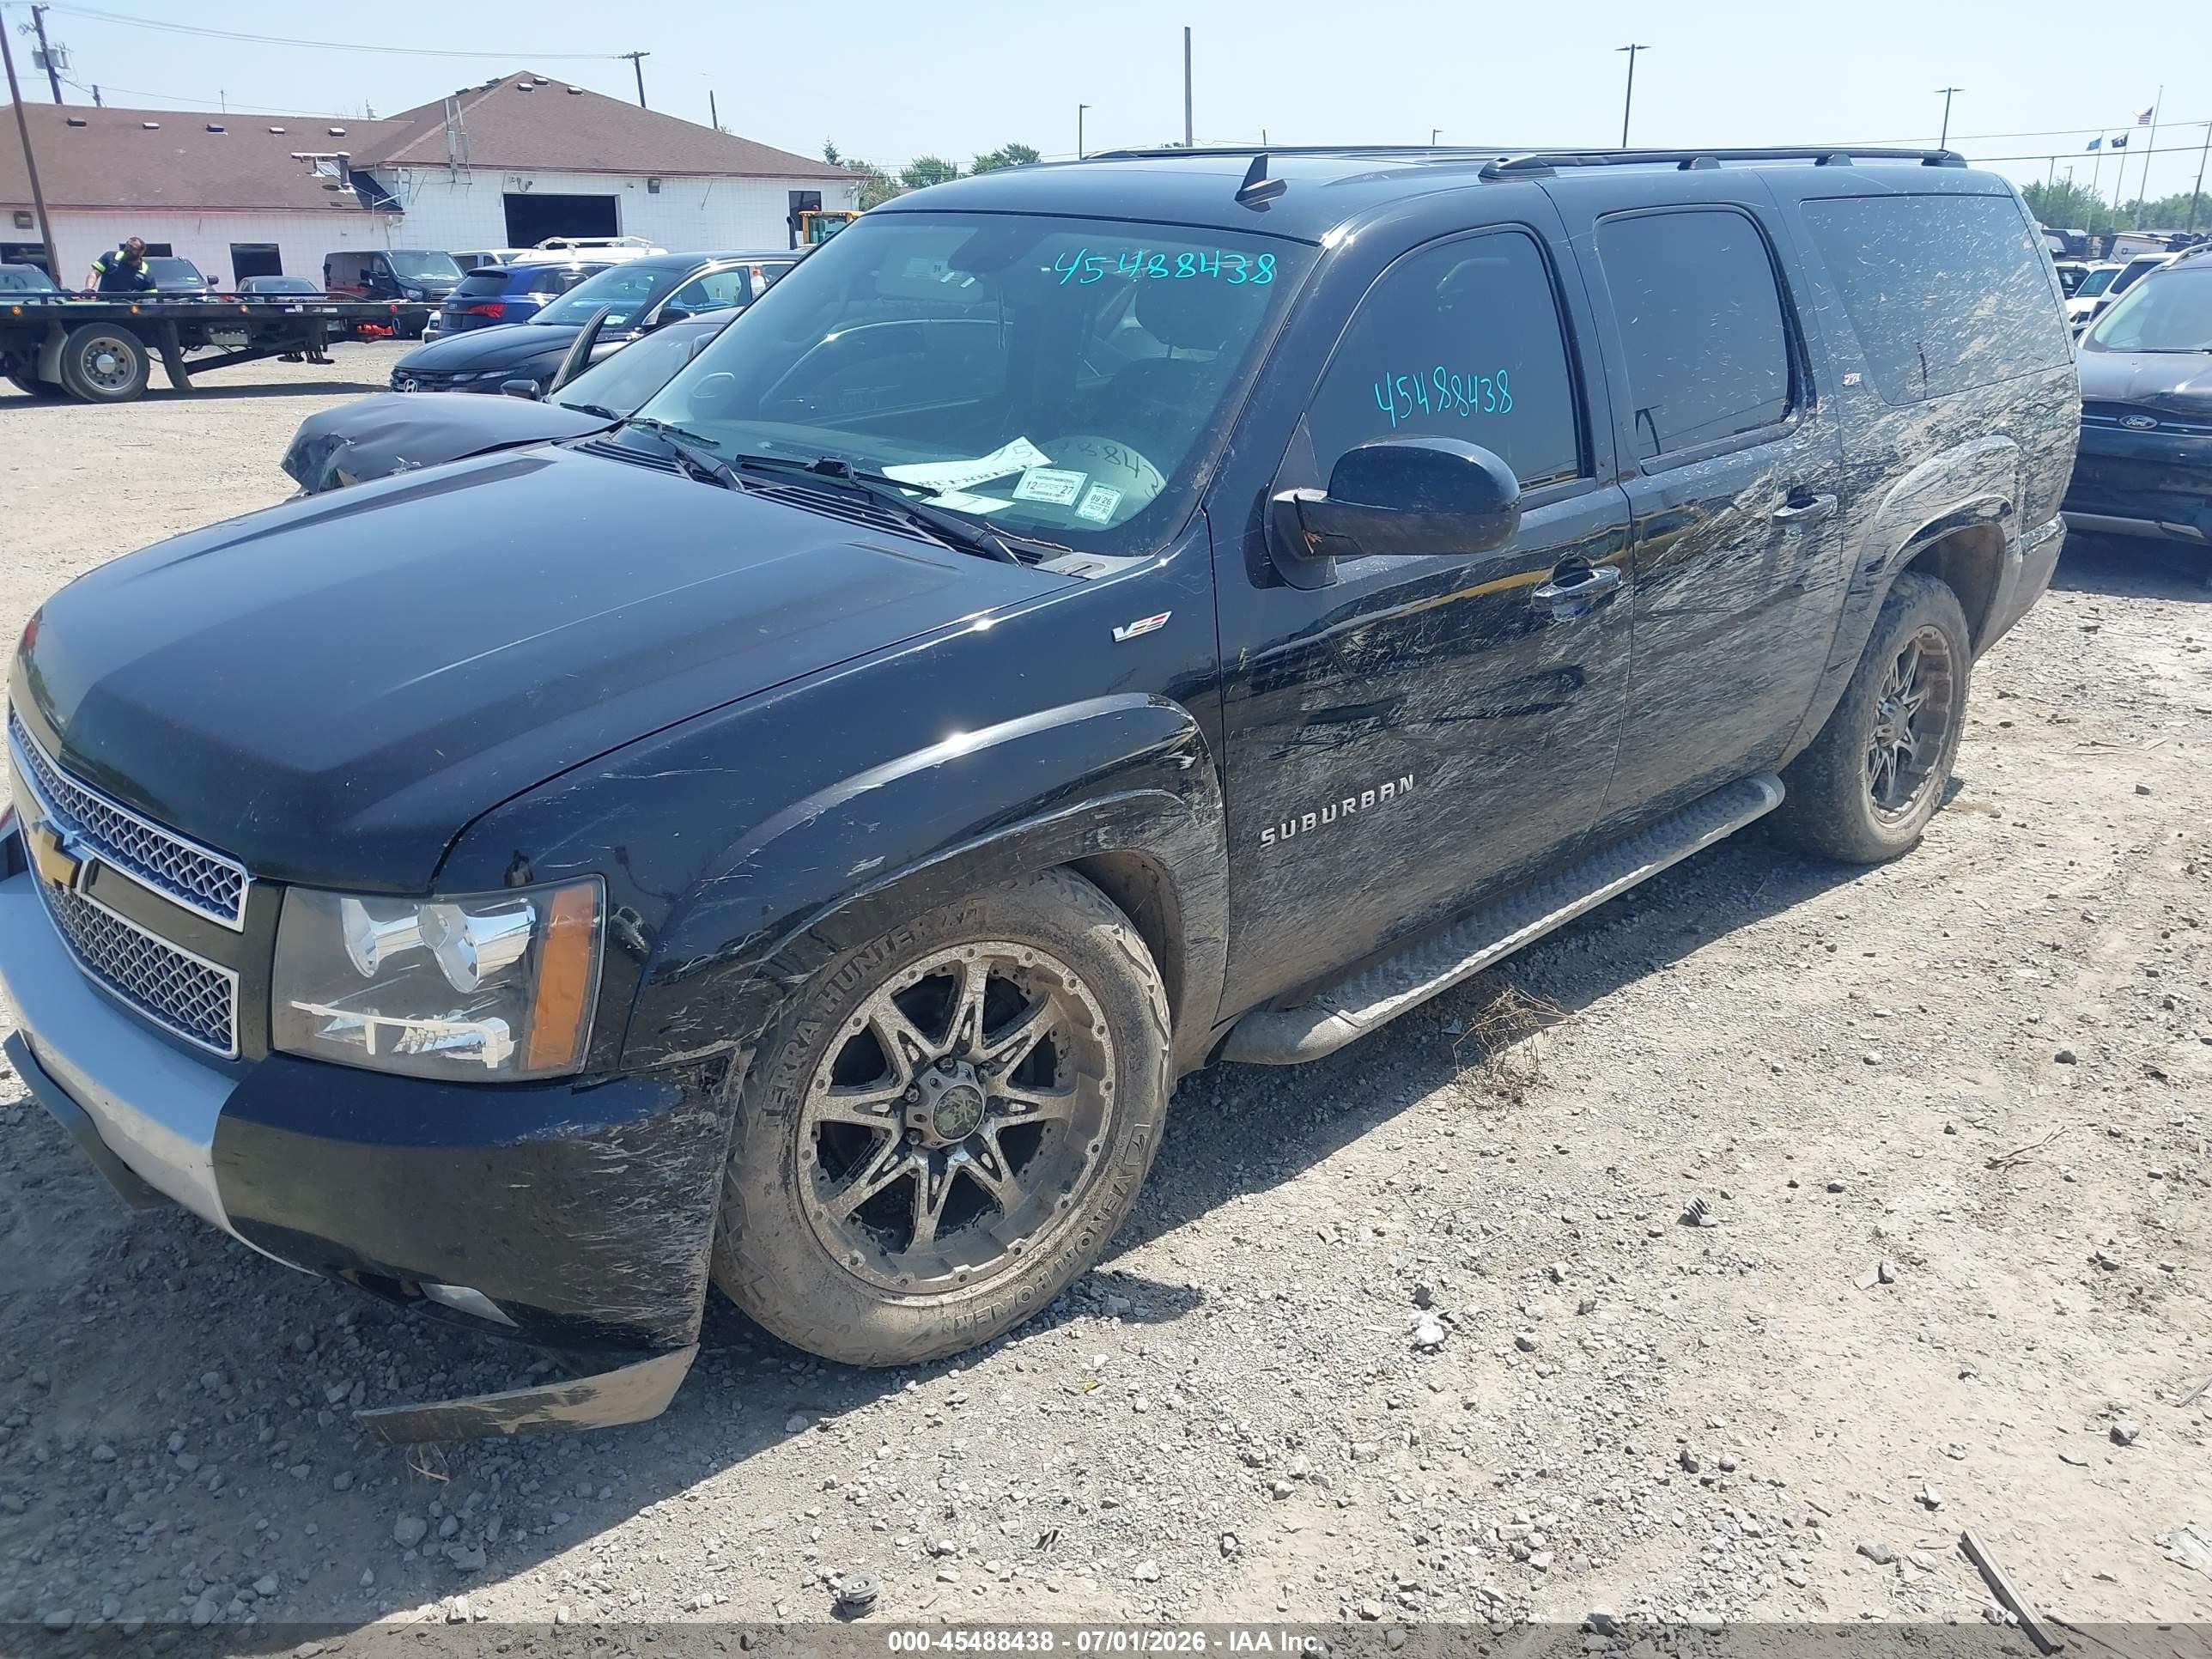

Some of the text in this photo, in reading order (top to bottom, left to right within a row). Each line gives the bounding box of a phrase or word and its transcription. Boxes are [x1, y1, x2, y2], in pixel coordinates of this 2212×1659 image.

[1054, 247, 1277, 286] 45488438
[1374, 366, 1513, 428] 45488438
[1025, 481, 1038, 490] 12
[1060, 485, 1074, 495] 27
[1091, 494, 1101, 502] 09
[1260, 774, 1414, 848] SUBURBAN
[757, 1020, 822, 1128] TERRA
[817, 908, 934, 1014] HUNTER
